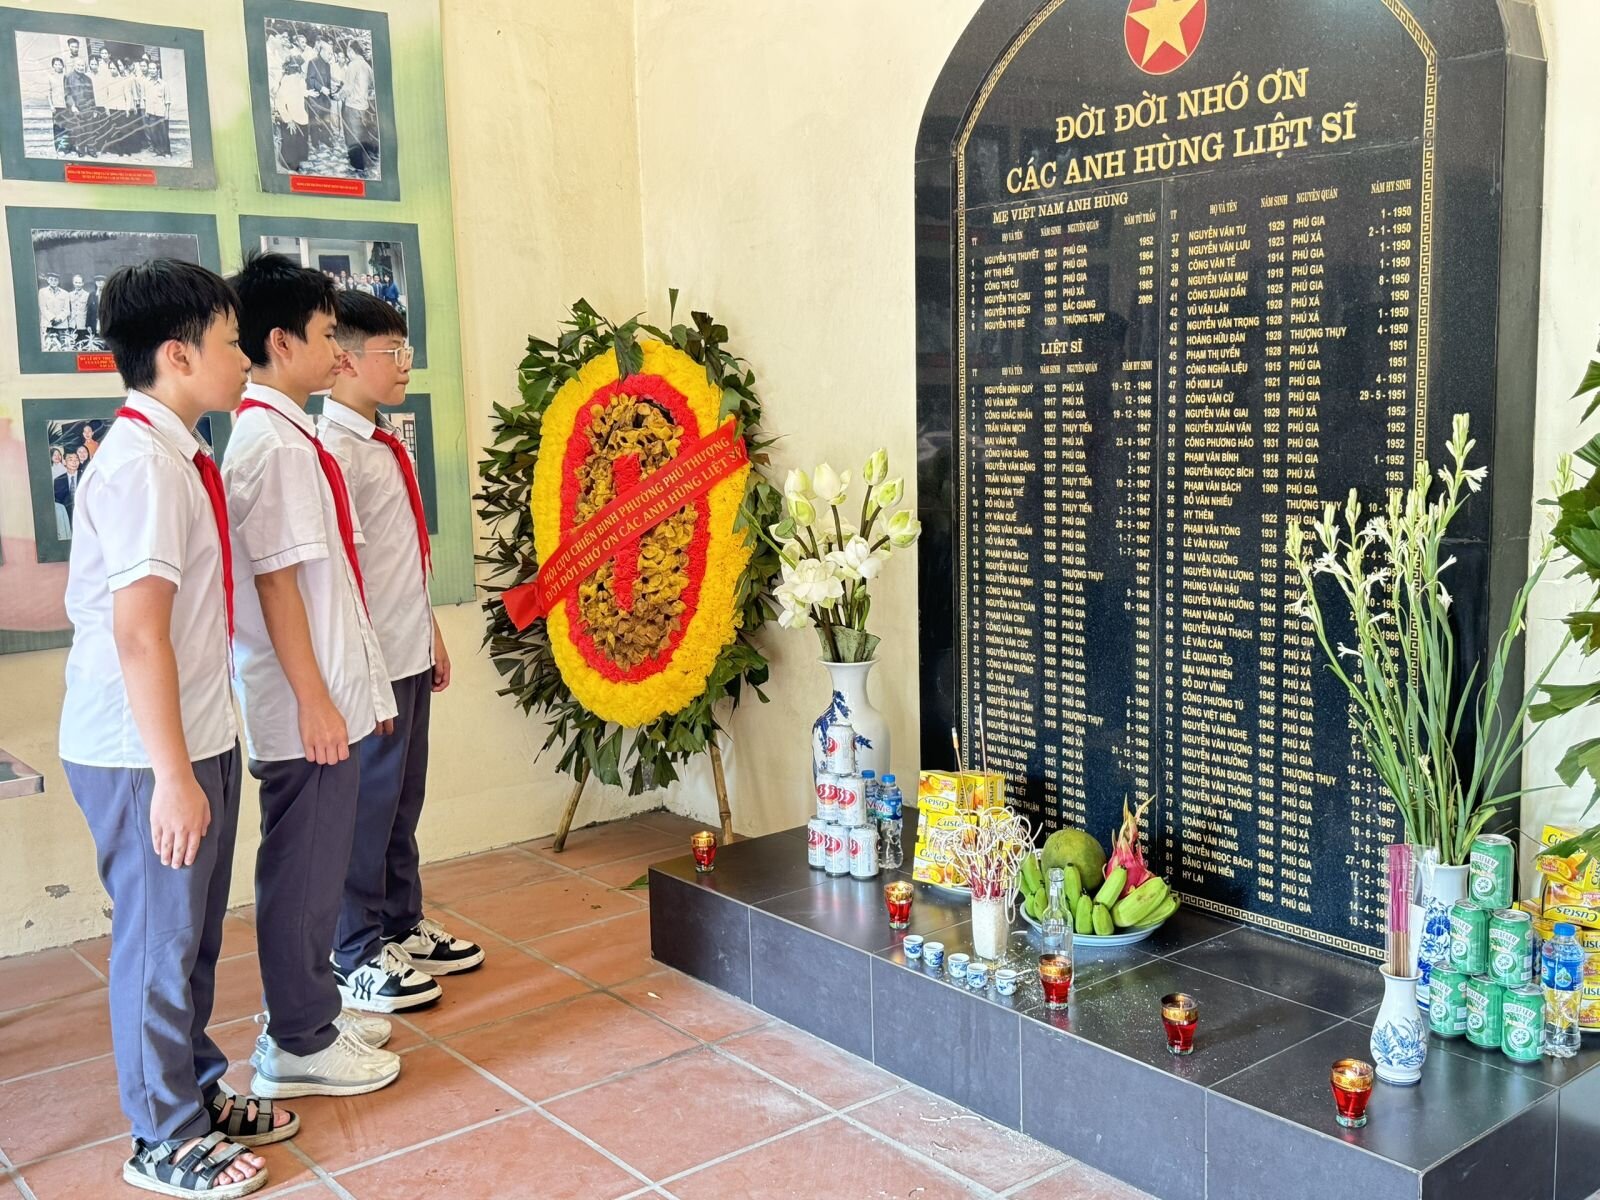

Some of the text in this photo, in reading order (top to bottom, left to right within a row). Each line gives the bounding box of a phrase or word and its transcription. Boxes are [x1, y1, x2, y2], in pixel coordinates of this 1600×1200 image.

[1055, 67, 1309, 144] ĐỜI ĐỜI NHỚ ƠN
[1006, 101, 1357, 194] CÁC ANH HÙNG LIỆT SĨ
[1385, 180, 1395, 192] HY
[1395, 178, 1411, 190] SINH
[992, 191, 1128, 225] MẸ VIỆT NAM ANH HÙNG
[1268, 219, 1285, 231] 1929
[1292, 214, 1309, 228] PHÚ
[1310, 215, 1325, 226] GIA
[1138, 235, 1153, 246] 1952
[1138, 250, 1153, 260] 1964
[1266, 299, 1282, 309] 1928
[1290, 294, 1307, 308] PHÚ
[1308, 293, 1320, 306] XÁ
[1390, 289, 1409, 300] 1950
[1040, 337, 1082, 356] LIỆT SĨ
[1207, 349, 1219, 360] THỊ
[1264, 345, 1281, 356] 1928
[1289, 344, 1306, 355] PHÚ
[1307, 341, 1318, 354] XÁ
[1388, 339, 1407, 350] 1951
[1264, 361, 1281, 371] 1915
[1289, 360, 1305, 370] PHÚ
[1306, 359, 1321, 370] GIA
[1388, 356, 1406, 367] 1951
[1263, 407, 1280, 417] 1929
[1287, 407, 1304, 417] PHÚ
[1305, 404, 1317, 416] XÁ
[1386, 405, 1406, 416] 1952
[1262, 438, 1278, 447] 1931
[1287, 437, 1303, 447] PHÚ
[1304, 438, 1319, 447] GIA
[1385, 438, 1405, 448] 1952
[1262, 468, 1278, 478] 1928
[1286, 468, 1302, 478] PHÚ
[1303, 466, 1315, 478] XÁ
[1385, 470, 1403, 481] 1953
[544, 437, 730, 584] HỘI CỰU CHIẾN BINH PHƯỜNG PHÚ THƯỢNG
[602, 532, 620, 551] ƠN
[619, 516, 643, 537] CÁC
[642, 499, 668, 524] ANH
[668, 475, 702, 505] HÙNG
[701, 456, 729, 481] LIỆT
[1061, 593, 1074, 603] PHÚ
[1074, 595, 1085, 605] GIA
[1259, 631, 1275, 642] 1937
[1283, 633, 1299, 645] PHÚ
[1300, 636, 1314, 647] GIA
[1061, 658, 1149, 680] PHÚ GIA 1949
[1258, 747, 1274, 758] 1947
[1281, 751, 1297, 763] PHÚ
[1299, 755, 1313, 766] GIA
[1182, 870, 1191, 879] HY
[1257, 890, 1273, 902] 1950
[1280, 896, 1296, 909] PHÚ
[1297, 901, 1311, 913] GIA
[1556, 906, 1598, 922] Custas
